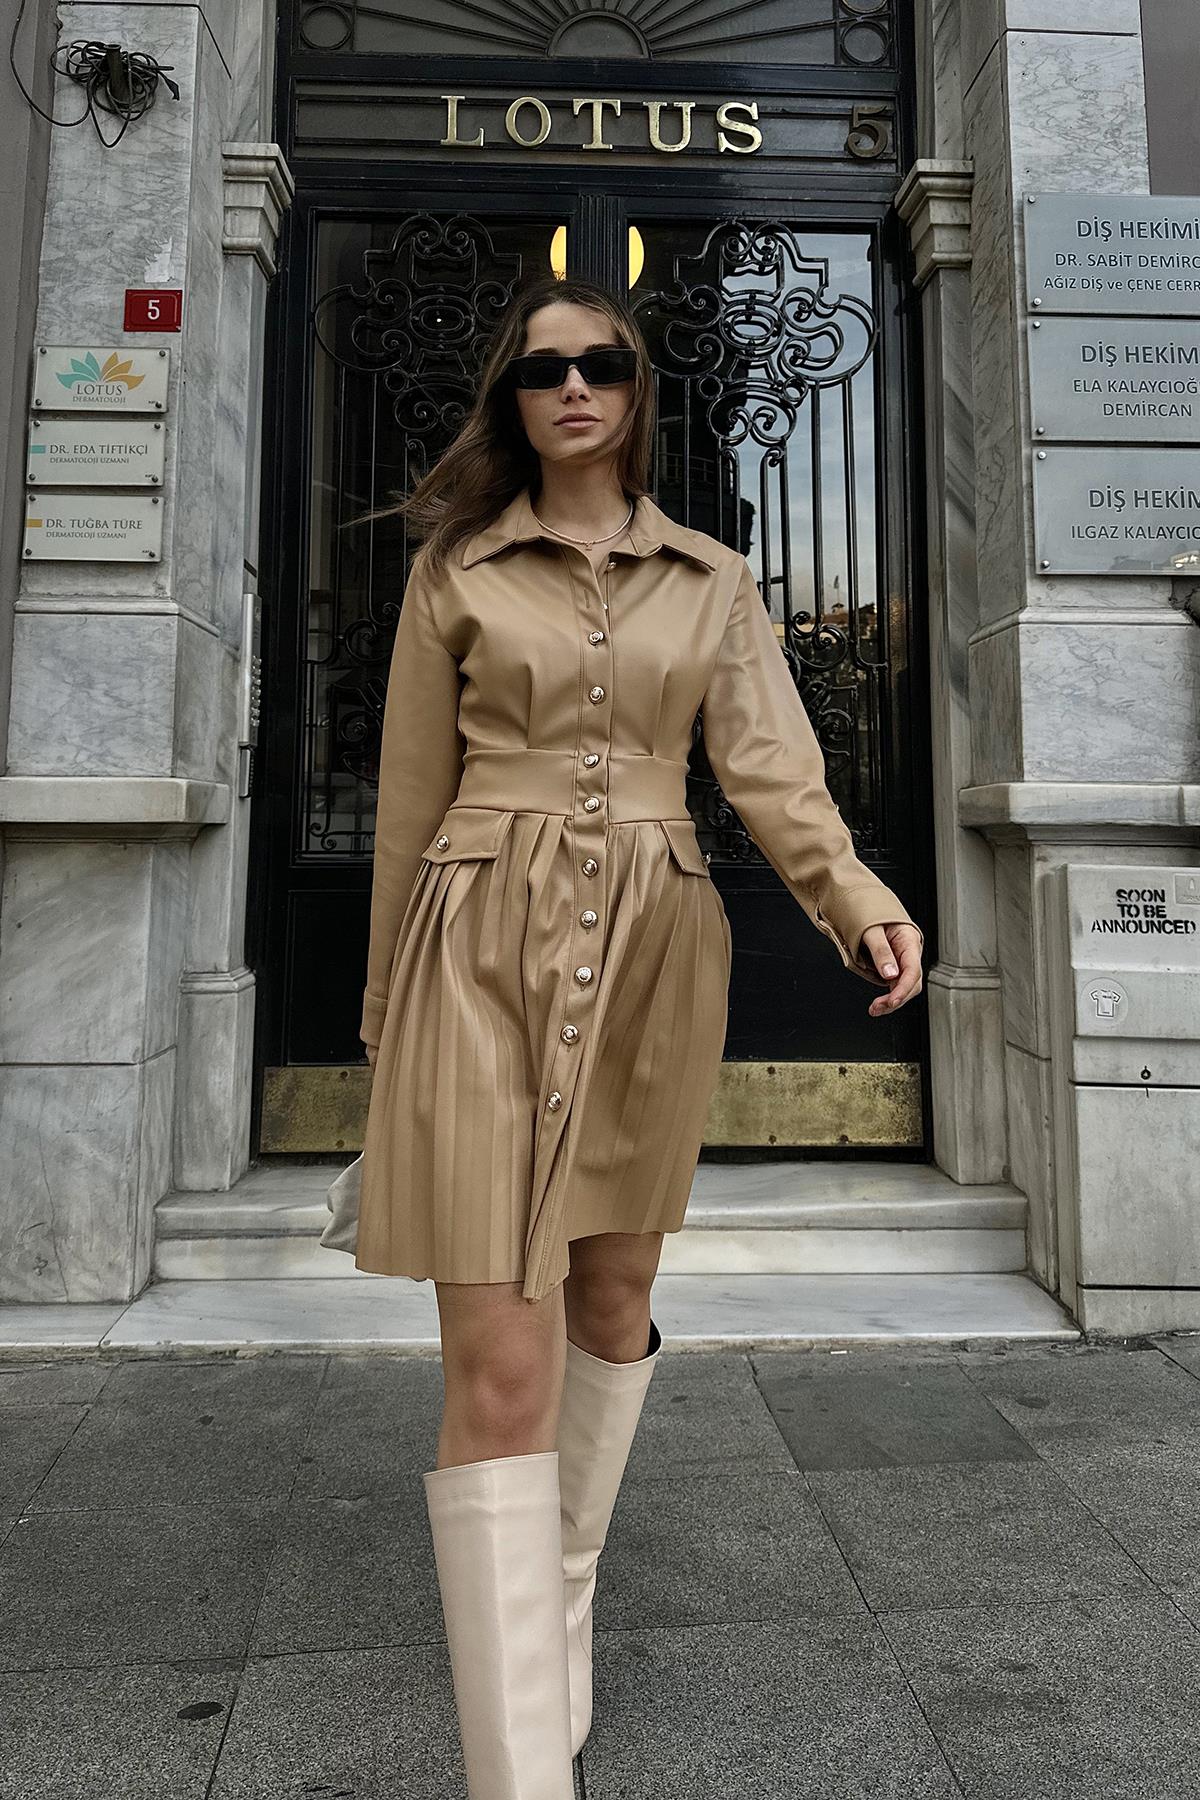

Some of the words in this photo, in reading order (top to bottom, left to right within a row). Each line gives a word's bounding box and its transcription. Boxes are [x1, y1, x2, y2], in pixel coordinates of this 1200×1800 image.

[440, 95, 763, 154] LOTUS
[846, 104, 888, 159] 5
[1077, 216, 1112, 242] DİŞ
[1120, 217, 1200, 239] HEKİMİ
[1055, 253, 1082, 266] DR.
[1087, 252, 1132, 267] SABİT
[1044, 275, 1076, 289] AĞIZ
[1081, 275, 1102, 292] DİŞ
[1107, 281, 1123, 290] ve
[1127, 279, 1162, 292] ÇENE
[147, 299, 160, 320] 5
[1081, 341, 1117, 368] DİŞ
[1125, 342, 1199, 364] HEKİM
[77, 384, 122, 395] LOTUS
[1073, 379, 1102, 393] ELA
[1108, 377, 1200, 394] KALAYCIOĞ
[1103, 401, 1192, 417] DEMİRCAN
[49, 444, 69, 454] DR.
[73, 444, 96, 454] EDA
[1089, 485, 1126, 512] DİŞ
[46, 518, 66, 528] DR.
[70, 517, 109, 529] TUĞBA
[1071, 525, 1119, 539] ILGAZ
[1116, 889, 1165, 903] SOON
[1117, 904, 1141, 918] TO
[1143, 905, 1167, 918] BE
[1091, 919, 1196, 934] ANNOUNCED
